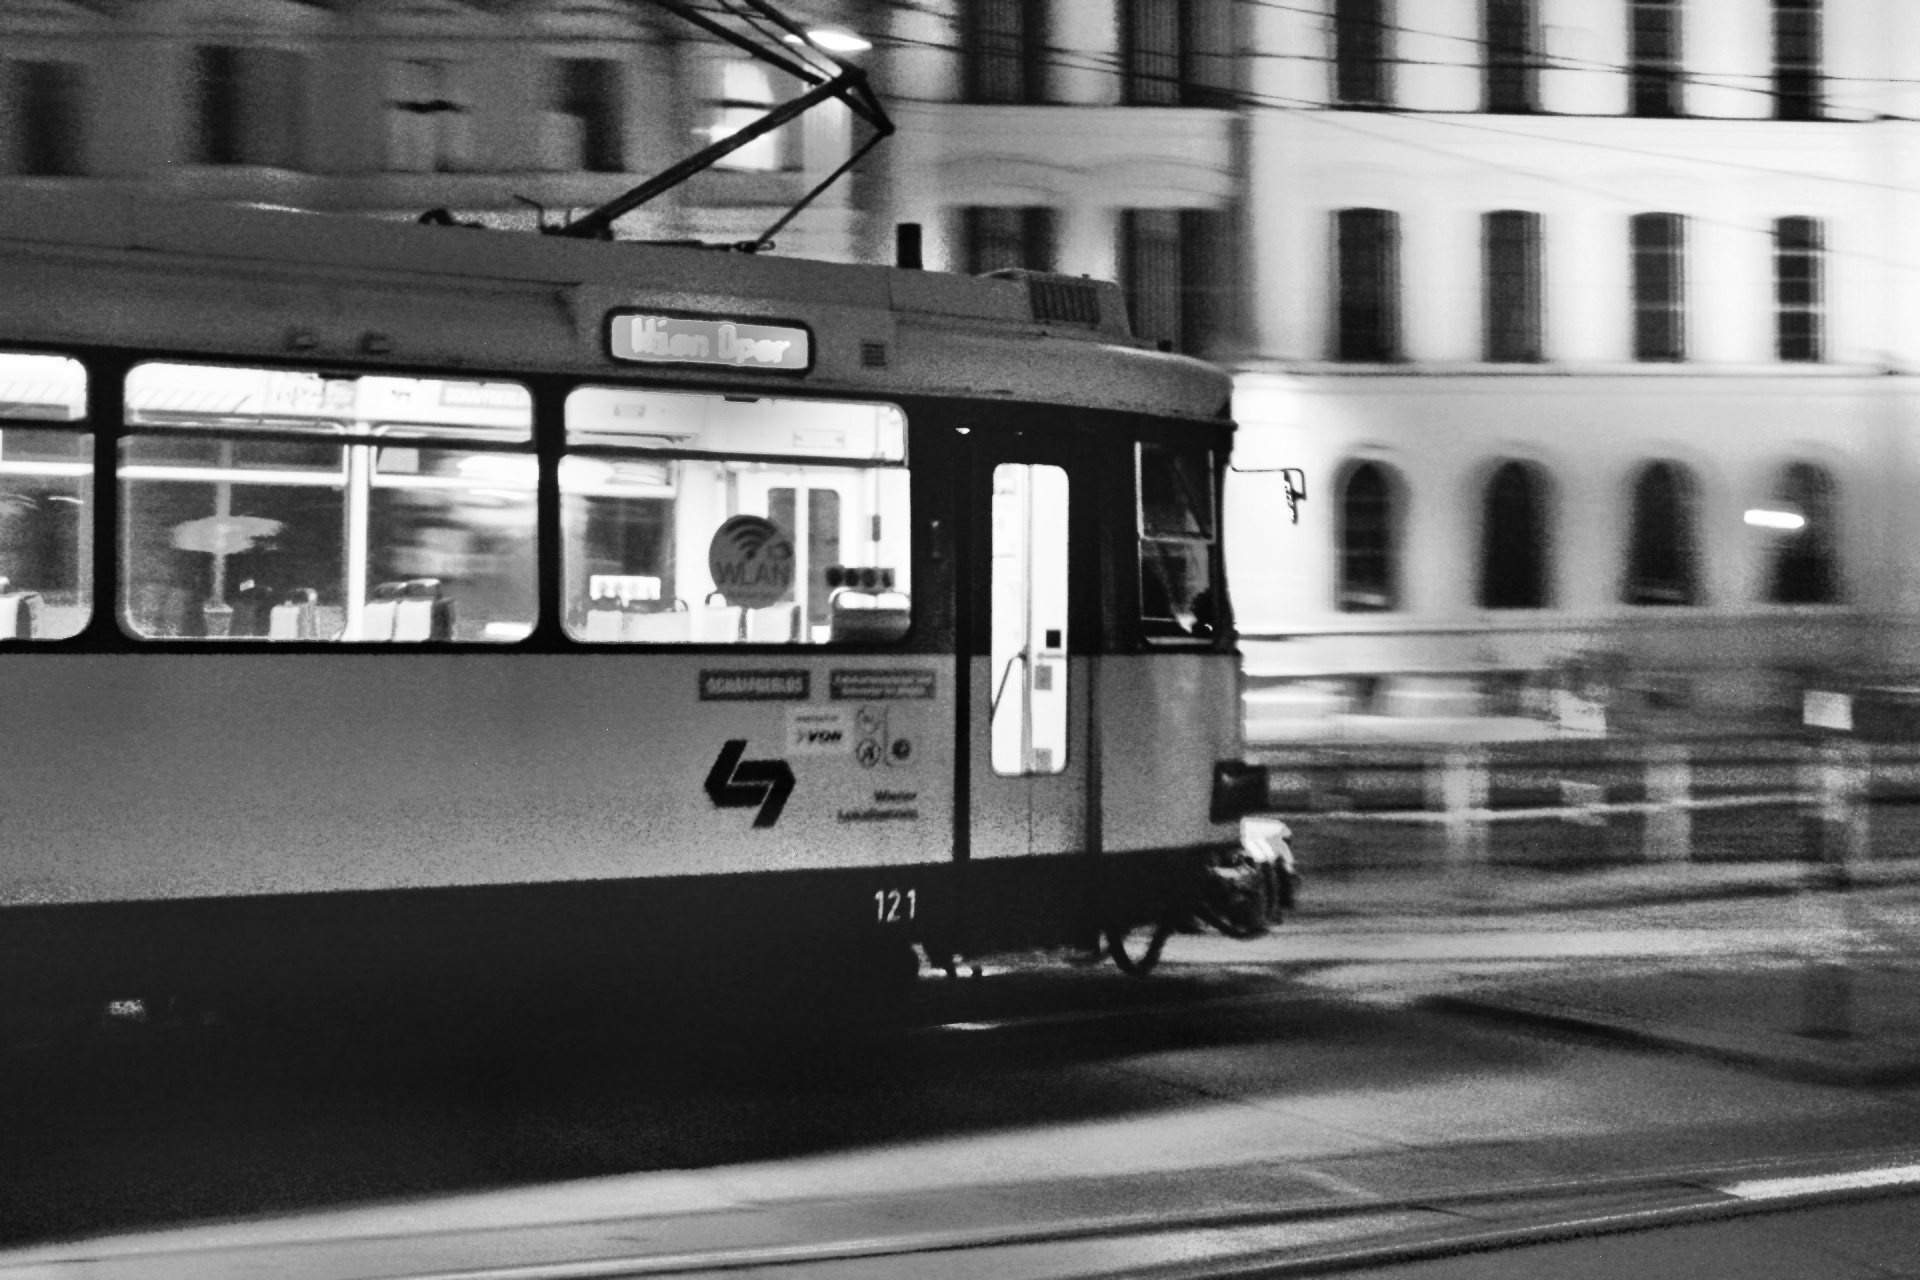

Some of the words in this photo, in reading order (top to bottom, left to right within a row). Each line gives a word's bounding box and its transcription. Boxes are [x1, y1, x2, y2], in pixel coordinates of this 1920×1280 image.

[717, 323, 792, 364] Oper
[716, 562, 791, 587] WLAN
[874, 888, 916, 922] 121
